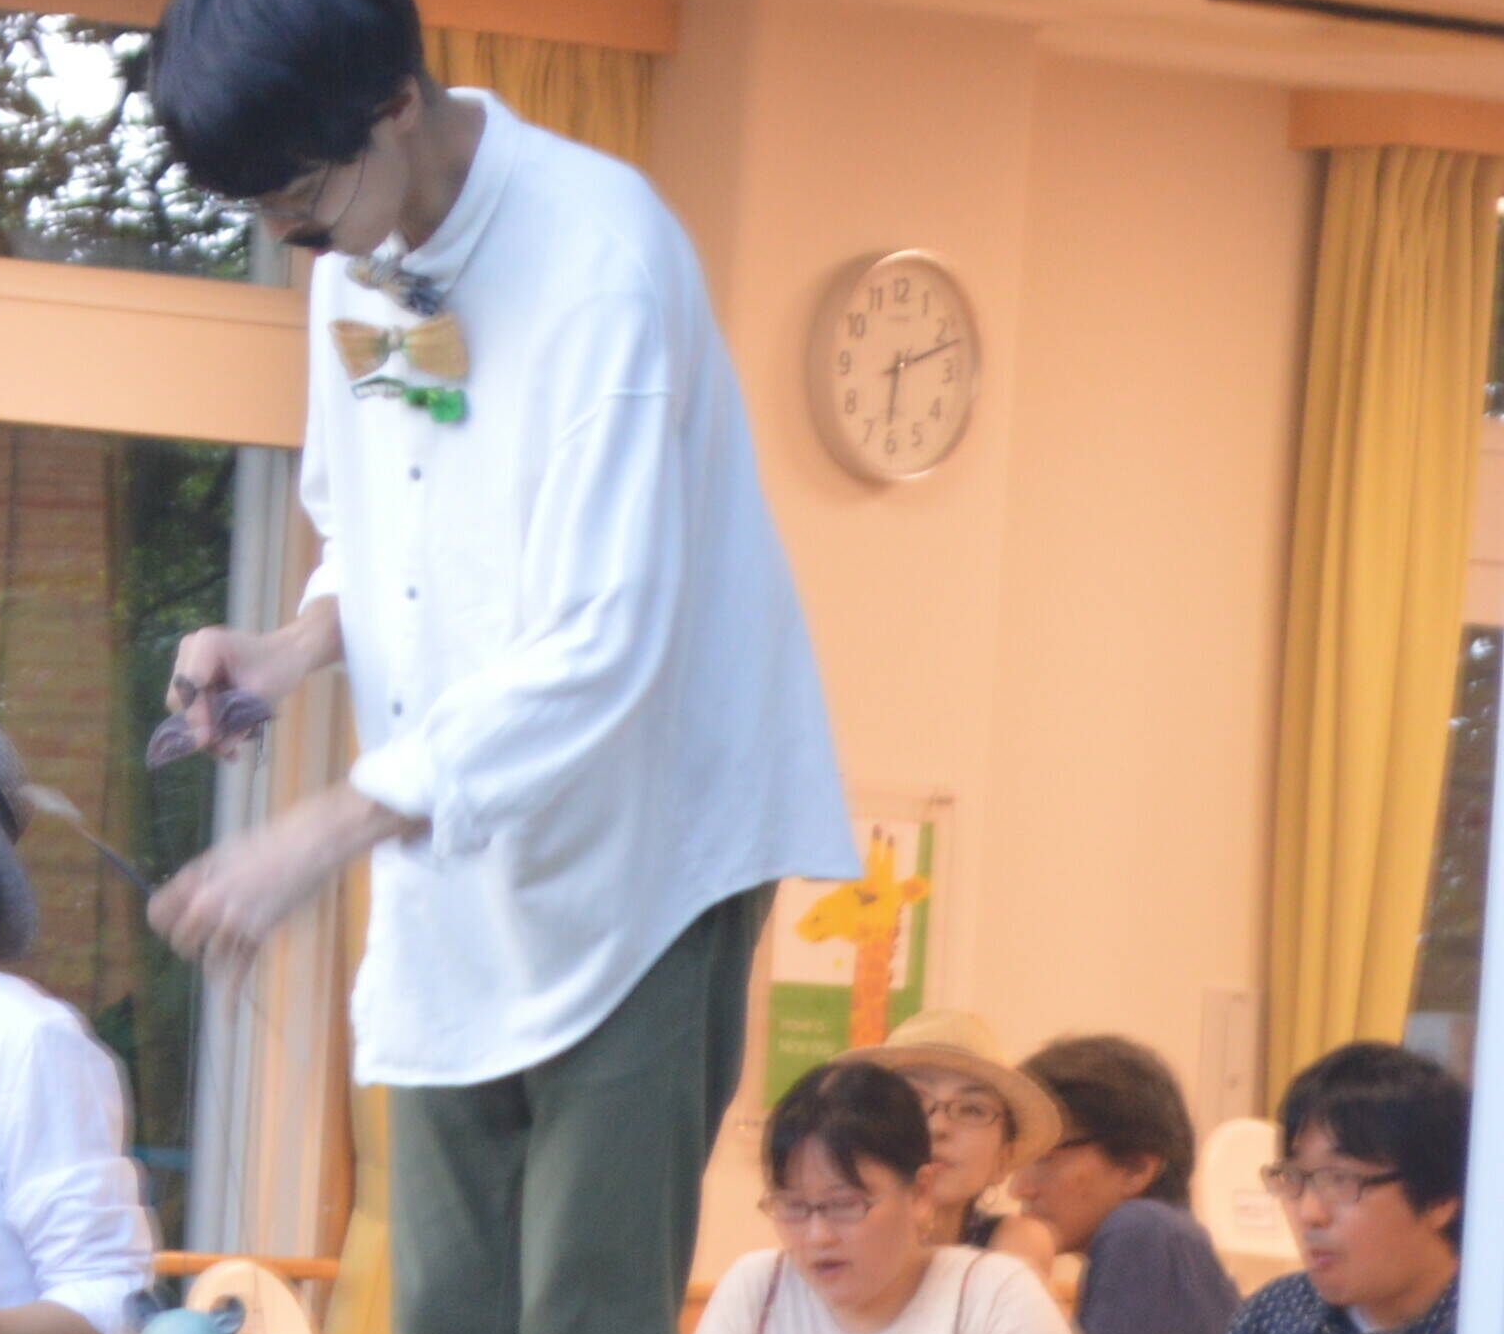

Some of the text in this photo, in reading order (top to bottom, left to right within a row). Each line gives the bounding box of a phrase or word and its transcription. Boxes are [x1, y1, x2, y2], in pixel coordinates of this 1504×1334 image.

[869, 286, 883, 311] 11
[894, 277, 910, 303] 12
[922, 290, 929, 316] 1
[848, 312, 866, 338] 10
[936, 318, 948, 344] 2
[840, 350, 852, 376] 9
[942, 358, 953, 384] 3
[845, 389, 857, 415] 8
[929, 396, 941, 420] 4
[863, 418, 874, 444] 7
[885, 429, 897, 455] 6
[912, 422, 922, 448] 5
